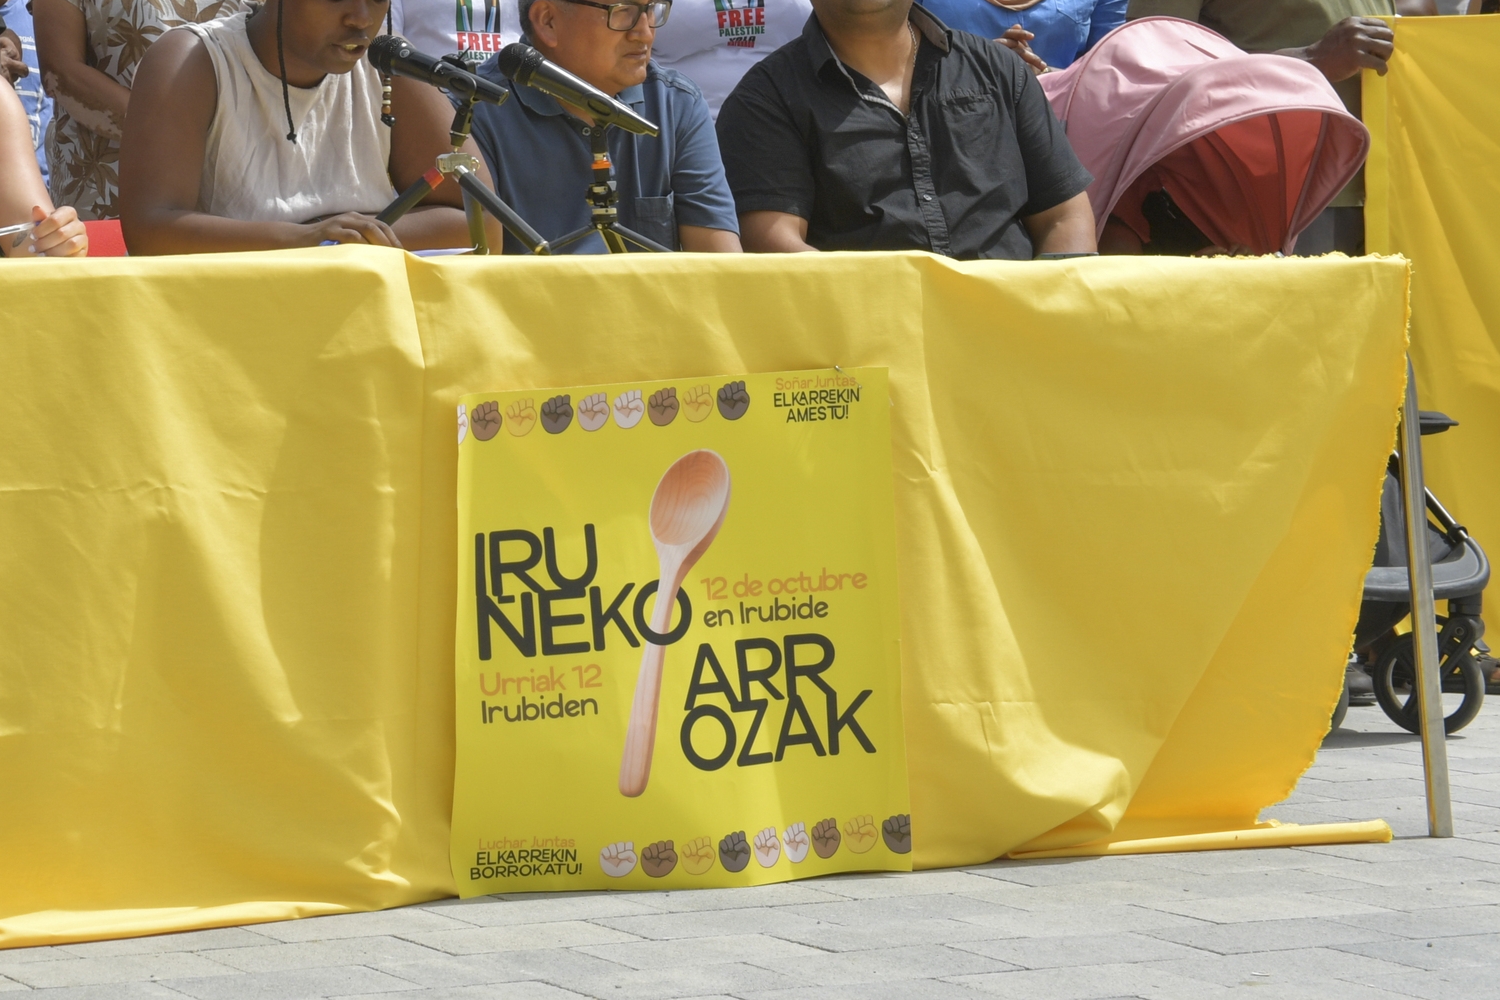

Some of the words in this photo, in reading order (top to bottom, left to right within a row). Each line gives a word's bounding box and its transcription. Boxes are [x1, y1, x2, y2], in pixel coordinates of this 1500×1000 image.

[717, 7, 765, 29] FREE
[457, 32, 501, 52] FREE
[719, 26, 765, 37] PALESTINE
[775, 376, 813, 391] Soñar
[814, 374, 856, 389] Juntas
[773, 388, 860, 407] ELKARREKIN
[475, 523, 598, 597] IRU
[700, 576, 728, 601] 12
[732, 573, 763, 598] de
[767, 567, 868, 595] octubre
[476, 579, 692, 661] NEKO
[703, 609, 734, 628] en
[740, 594, 829, 624] Irubide
[479, 666, 566, 696] Urriak
[571, 664, 603, 689] 12
[684, 633, 837, 711] ARR
[481, 693, 599, 724] Irubiden
[680, 689, 877, 771] OZAK
[478, 836, 527, 850] Luchar
[530, 835, 575, 848] Juntas
[476, 848, 576, 865] ELKARREKIN
[470, 863, 582, 880] BORROKATU!
